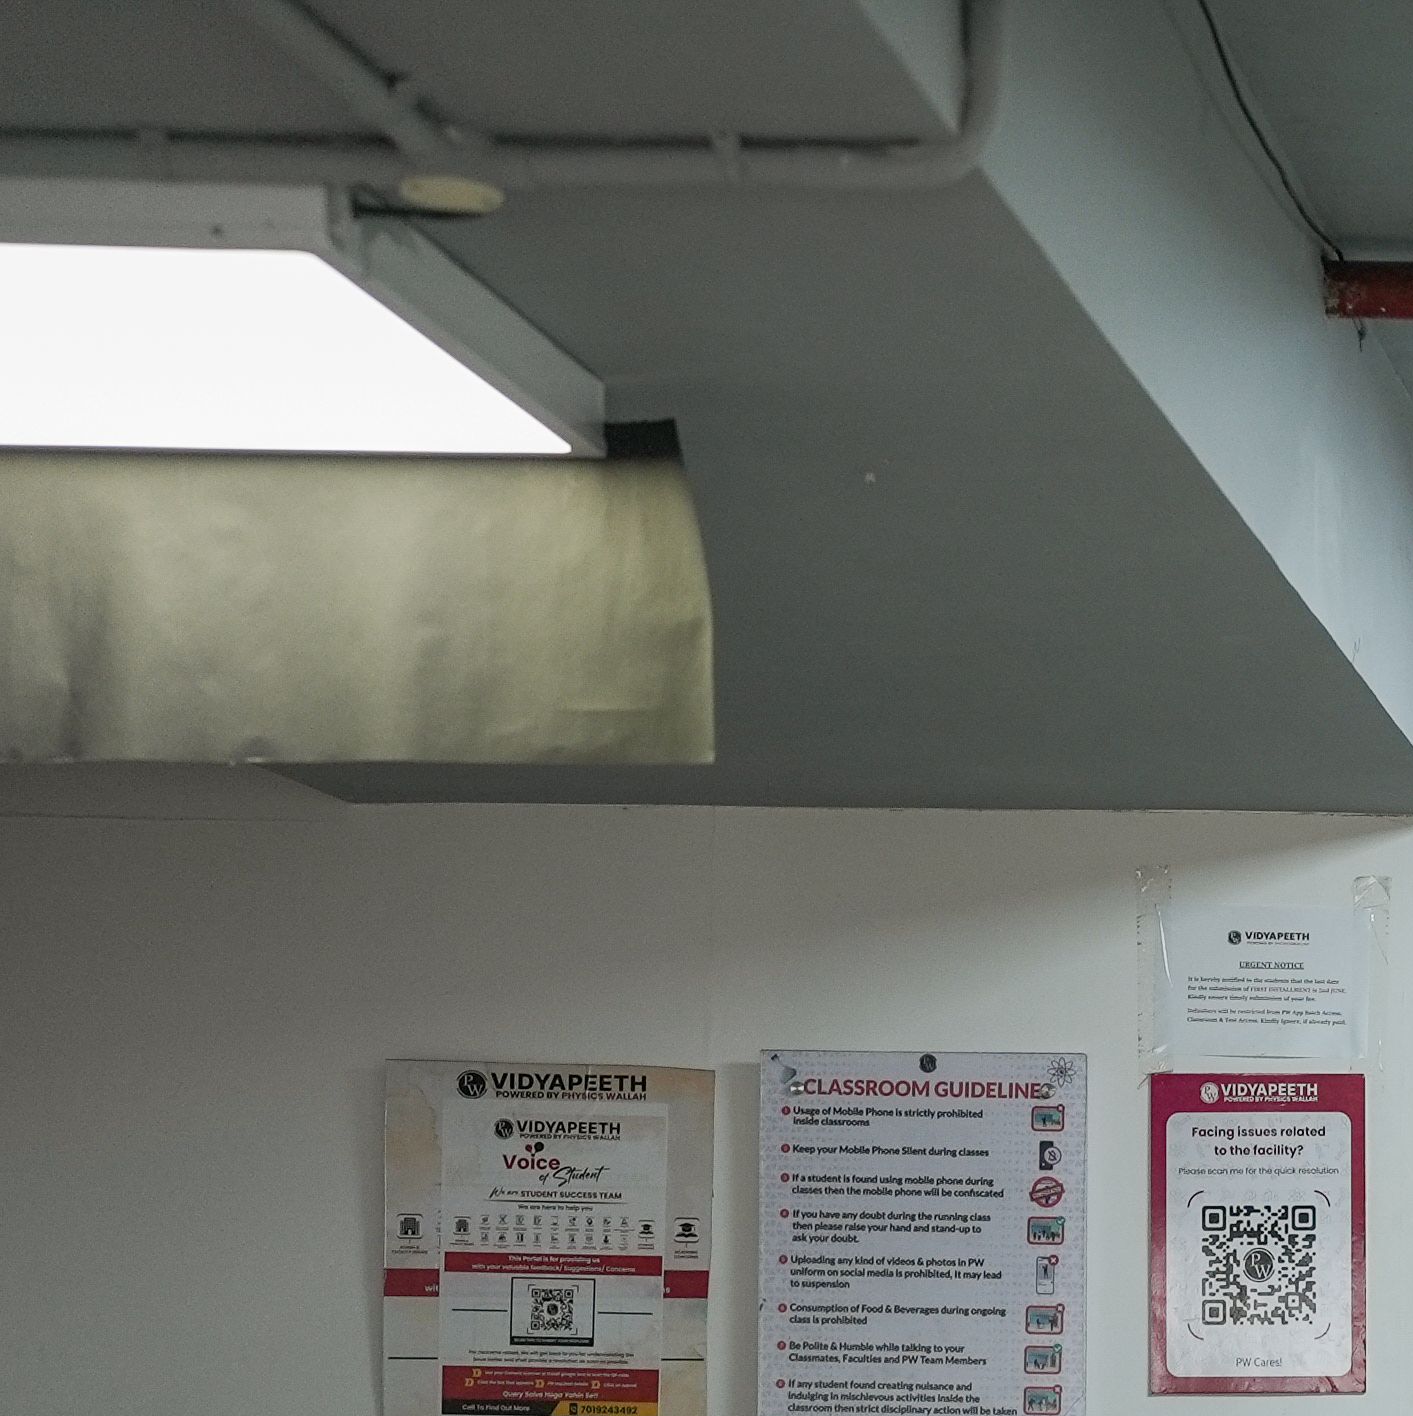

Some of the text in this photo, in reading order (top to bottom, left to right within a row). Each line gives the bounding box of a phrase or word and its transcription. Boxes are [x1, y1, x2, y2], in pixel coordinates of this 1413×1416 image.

[1244, 931, 1310, 941] VIDYAPEETH
[1274, 961, 1304, 970] NOTICE
[490, 1072, 647, 1092] VIDYAPEETH
[802, 1078, 1042, 1100] CLASSROOM GUIDELINE
[1220, 1082, 1317, 1096] VIDYAPEETH
[495, 1090, 544, 1099] POWERED
[546, 1091, 559, 1099] BY
[605, 1092, 646, 1101] WALLAH
[792, 1105, 983, 1120] Usage of Mobile Phone is strictly prohibited
[516, 1120, 621, 1135] VIDYAPEETH
[792, 1116, 870, 1127] inside classrooms
[1191, 1125, 1326, 1140] Facing issues related
[792, 1144, 989, 1158] Keep your Mobile Phone Silent during classes
[1214, 1143, 1304, 1158] to the facility?
[502, 1153, 561, 1171] Voice
[552, 1166, 610, 1188] Student
[1178, 1167, 1206, 1175] Please
[1245, 1167, 1257, 1175] for
[1258, 1167, 1273, 1175] the
[1273, 1166, 1296, 1176] quick
[1298, 1166, 1339, 1175] resolution
[792, 1173, 799, 1182] If
[807, 1173, 842, 1183] student
[843, 1174, 850, 1183] is
[851, 1174, 878, 1184] found
[879, 1174, 903, 1186] using
[904, 1175, 935, 1185] mobile
[935, 1175, 964, 1186] phone
[964, 1176, 994, 1188] during
[520, 1190, 558, 1198] STUDENT
[559, 1191, 597, 1199] SUCCESS
[791, 1185, 1004, 1198] classes then the mobile phone will be confiscated
[1235, 1356, 1282, 1367] PW Cares!
